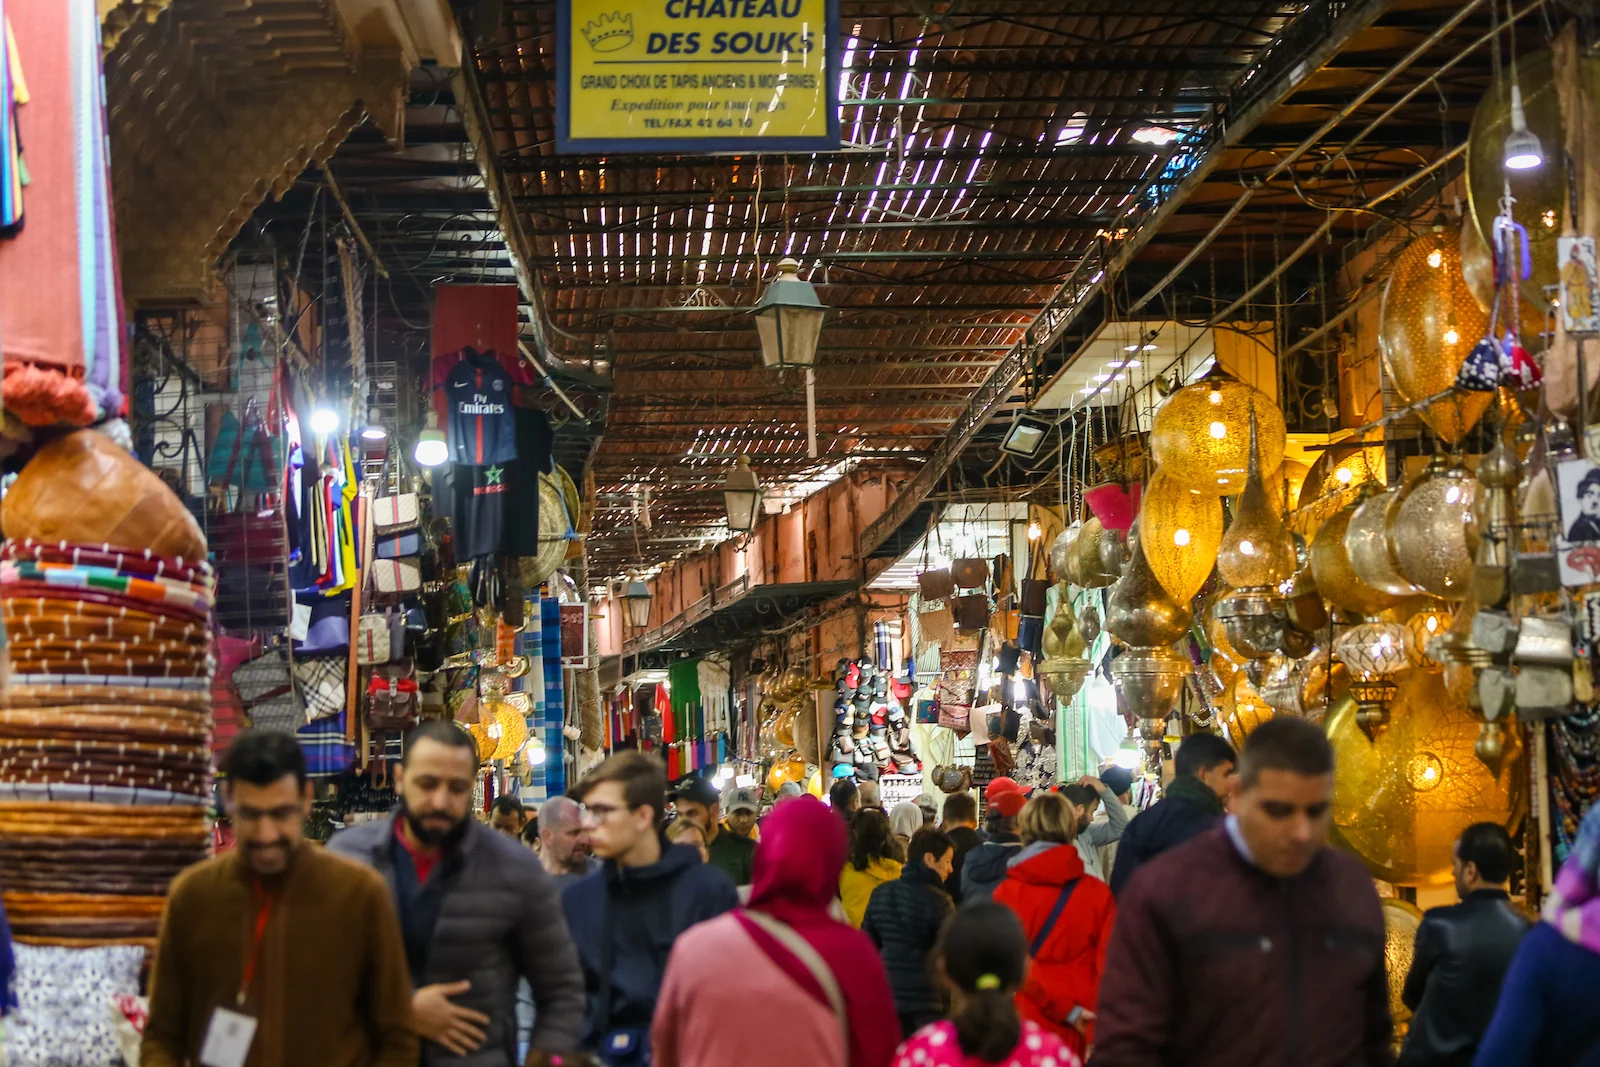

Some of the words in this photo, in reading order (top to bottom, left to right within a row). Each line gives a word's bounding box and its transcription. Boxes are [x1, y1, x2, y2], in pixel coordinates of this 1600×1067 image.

[665, 0, 801, 19] CHATEAU
[646, 32, 700, 55] DES
[710, 31, 815, 54] SOUKS
[581, 75, 617, 90] GRAND
[620, 75, 651, 90] CHOIX
[654, 75, 667, 89] DE
[670, 74, 699, 89] TAPIS
[702, 74, 746, 89] ANCIENS
[749, 74, 755, 88] &
[610, 98, 684, 113] Expedition
[687, 101, 720, 113] pour
[755, 101, 787, 113] pas
[643, 118, 692, 129] TEL/FAX
[697, 118, 713, 128] 42
[717, 118, 733, 128] 64
[738, 118, 753, 128] 10
[474, 394, 488, 404] Fly
[459, 401, 504, 414] Emirates
